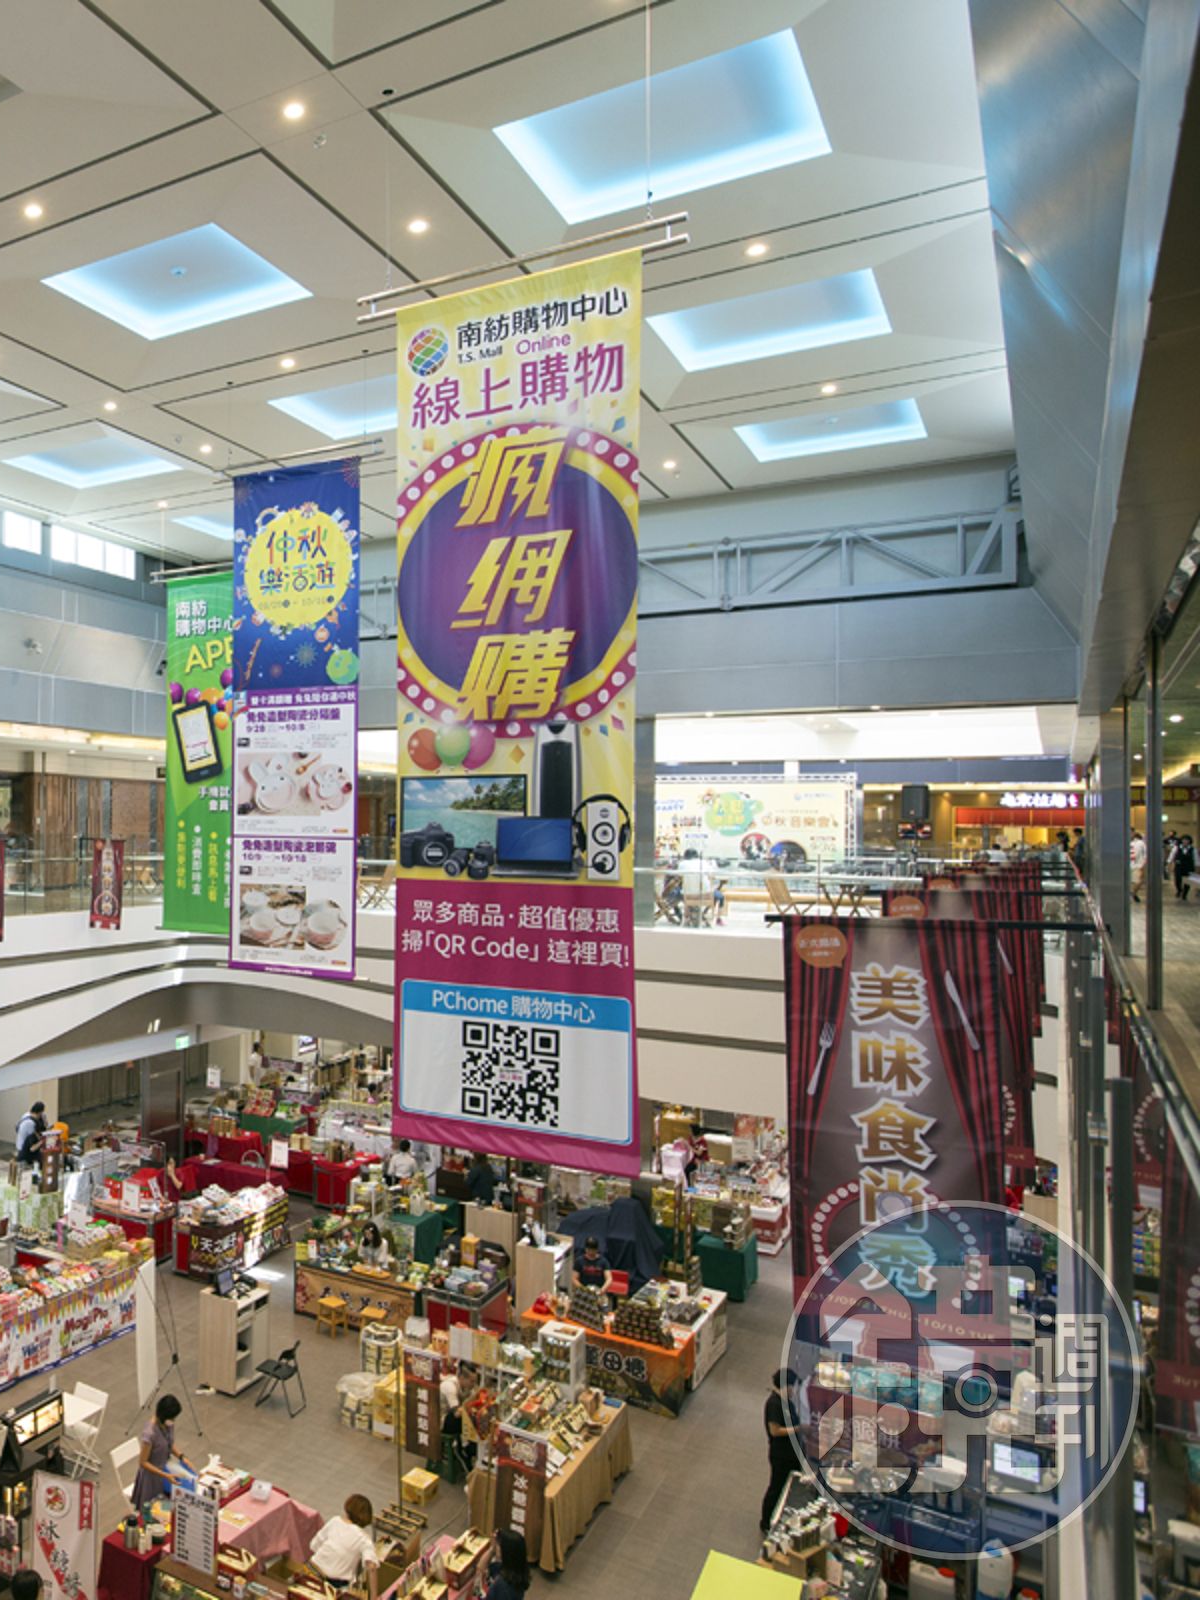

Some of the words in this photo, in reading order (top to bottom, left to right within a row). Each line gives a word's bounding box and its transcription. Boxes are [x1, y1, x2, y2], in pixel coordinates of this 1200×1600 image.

[457, 286, 629, 349] 南紡購物中心
[479, 345, 503, 361] Mall
[516, 332, 571, 355] Online
[411, 343, 625, 430] 線上購物
[266, 526, 328, 565] 仲秋
[175, 600, 207, 618] 南紡
[175, 617, 234, 637] 購物中心
[432, 990, 508, 1016] PChome
[511, 997, 595, 1023] 購物中心
[850, 961, 939, 1299] 美味食尚秀
